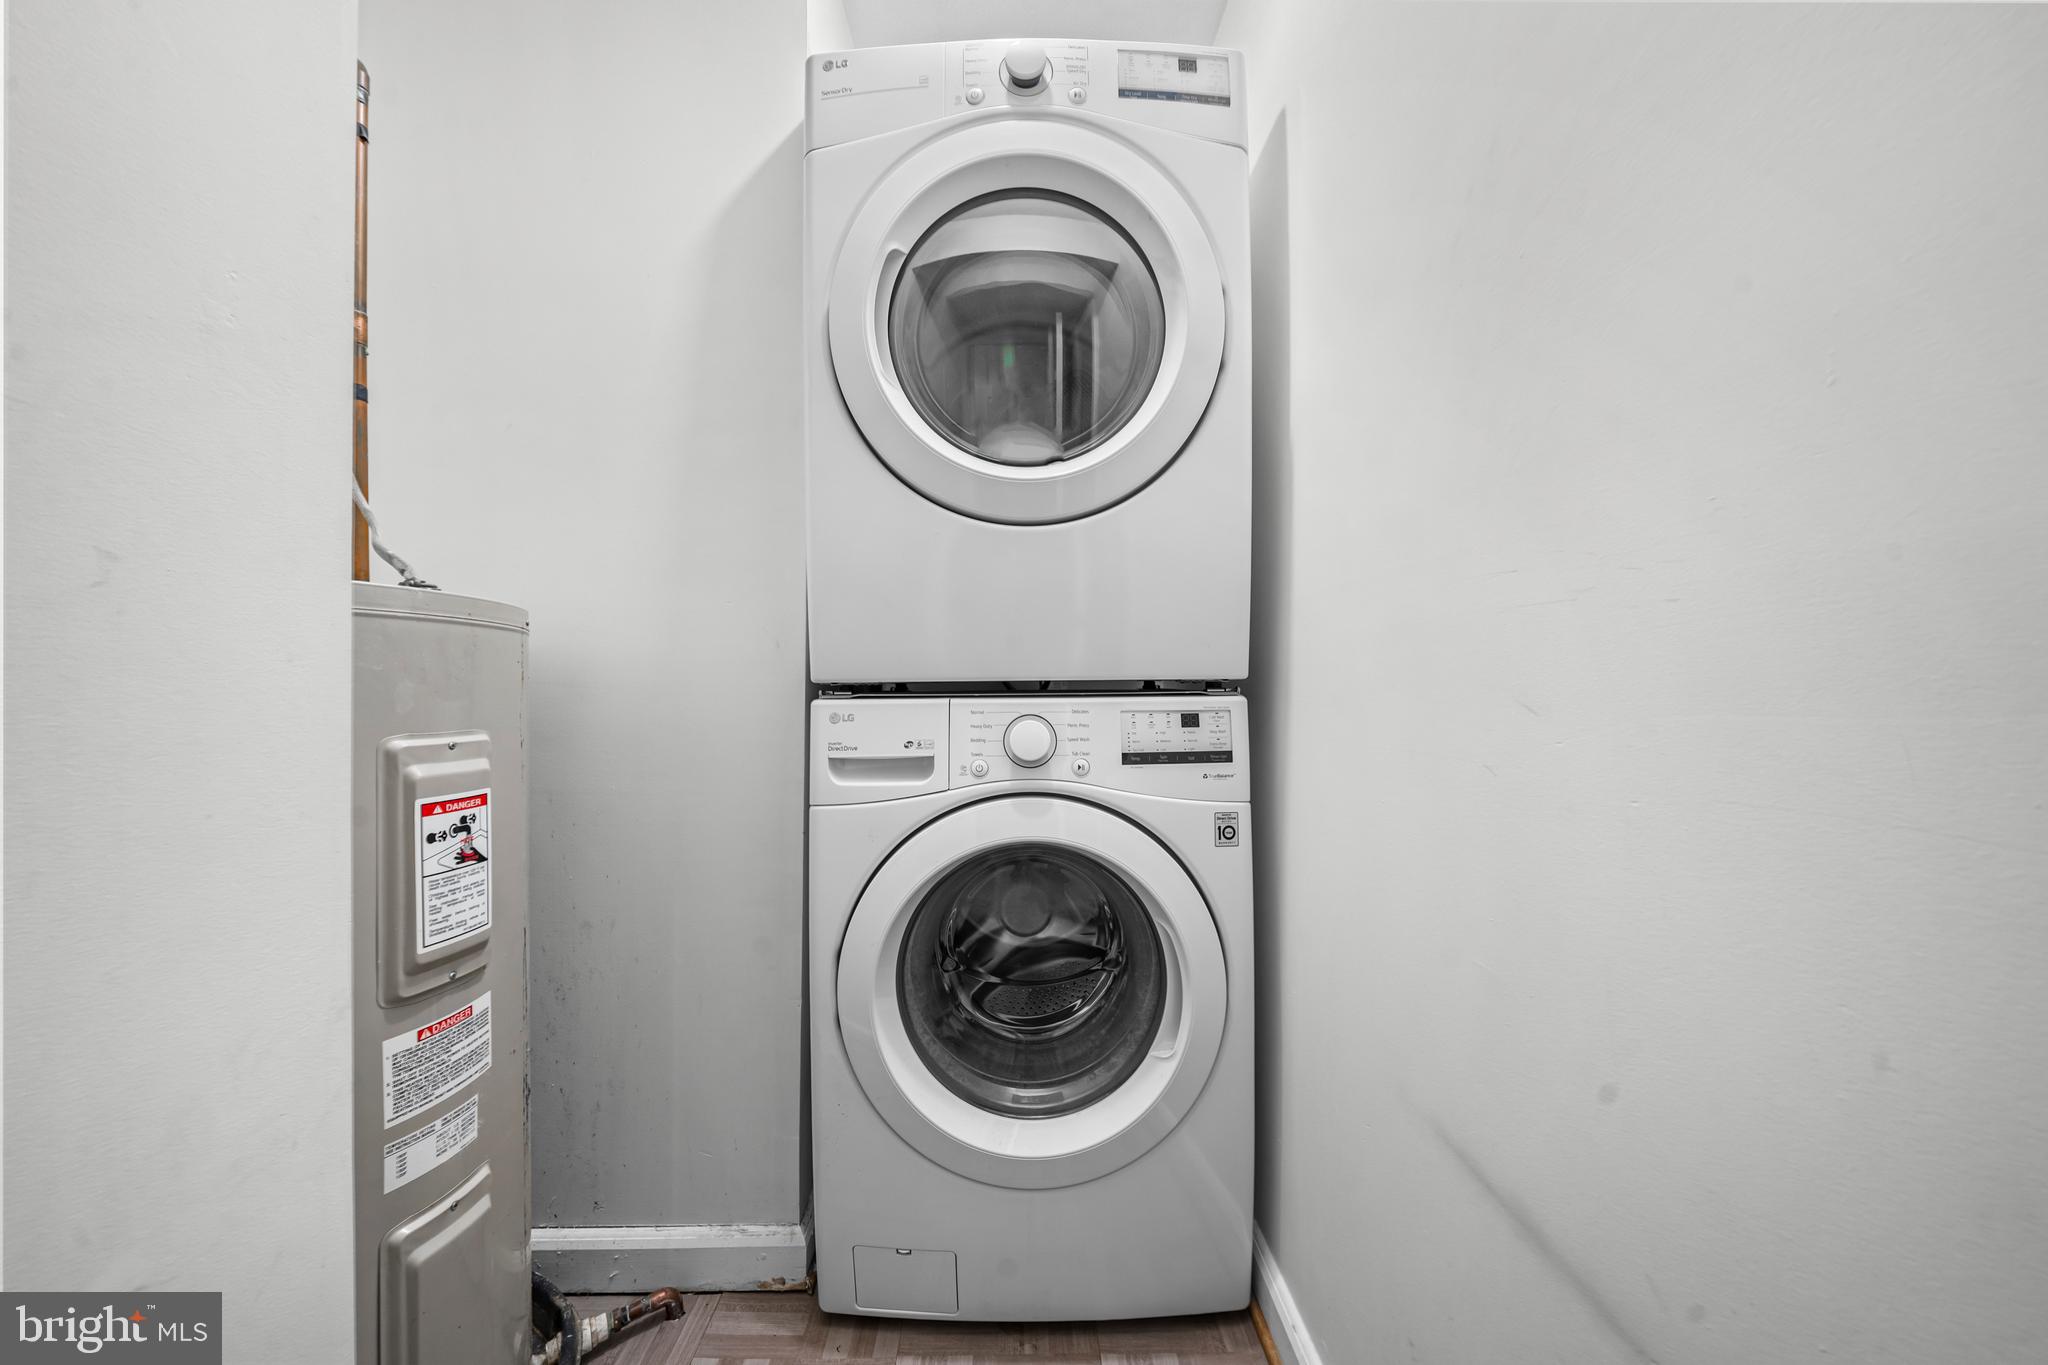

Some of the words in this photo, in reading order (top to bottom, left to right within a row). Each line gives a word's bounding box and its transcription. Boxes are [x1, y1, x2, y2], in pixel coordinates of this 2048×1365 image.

[841, 87, 853, 95] Dry
[445, 798, 481, 812] DANGER
[1217, 825, 1236, 841] 10
[432, 1007, 472, 1035] DANGER
